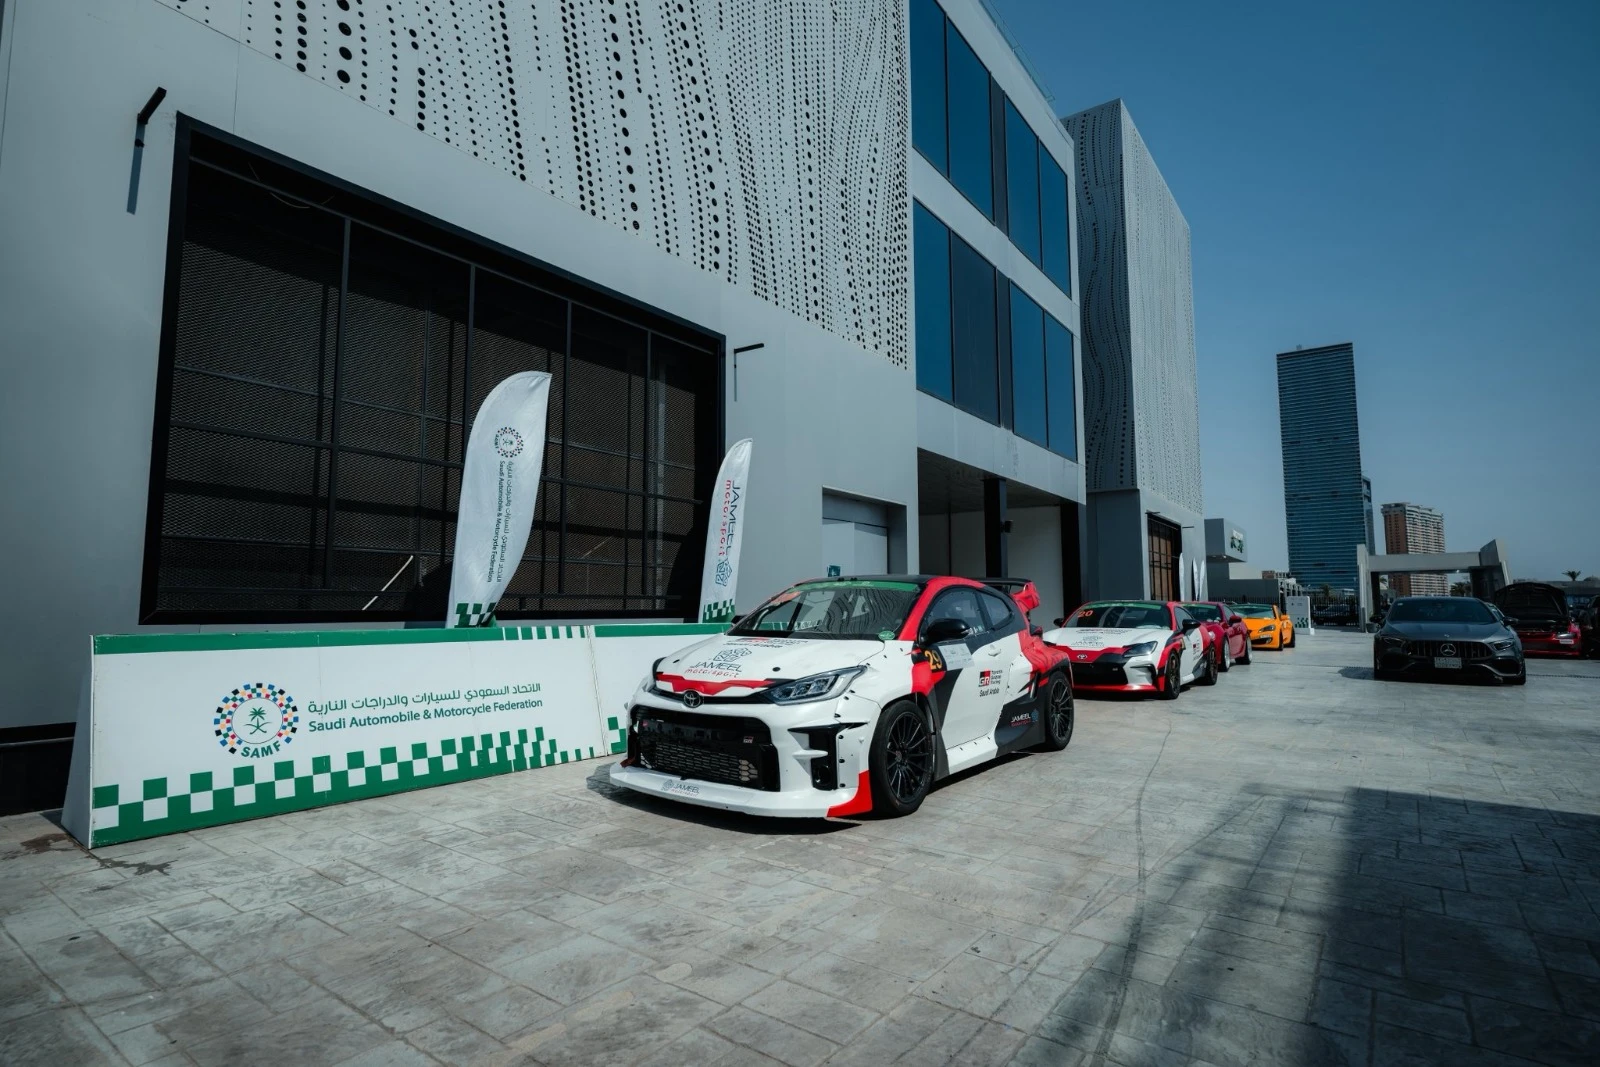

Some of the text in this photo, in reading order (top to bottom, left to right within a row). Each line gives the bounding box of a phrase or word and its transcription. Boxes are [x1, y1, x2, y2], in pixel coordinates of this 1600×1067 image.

[497, 477, 505, 512] Automobile
[718, 479, 732, 556] motorsport
[725, 480, 741, 556] JAMEEL
[492, 518, 502, 550] Motorcycle
[487, 551, 498, 583] Federation
[1078, 610, 1094, 618] 20
[690, 661, 742, 673] JAMEEL
[924, 650, 943, 670] 29
[684, 668, 740, 678] motorsport
[308, 683, 541, 715] الاتحاد السعودي للسيارات والدراجات النارية
[980, 687, 1000, 697] Saudi Arabia
[308, 699, 543, 732] Saudi Automobile & Motorcycle Federation
[1010, 713, 1032, 722] JAMEEL
[240, 740, 281, 758] SAMF
[674, 783, 700, 794] JAMEEL
